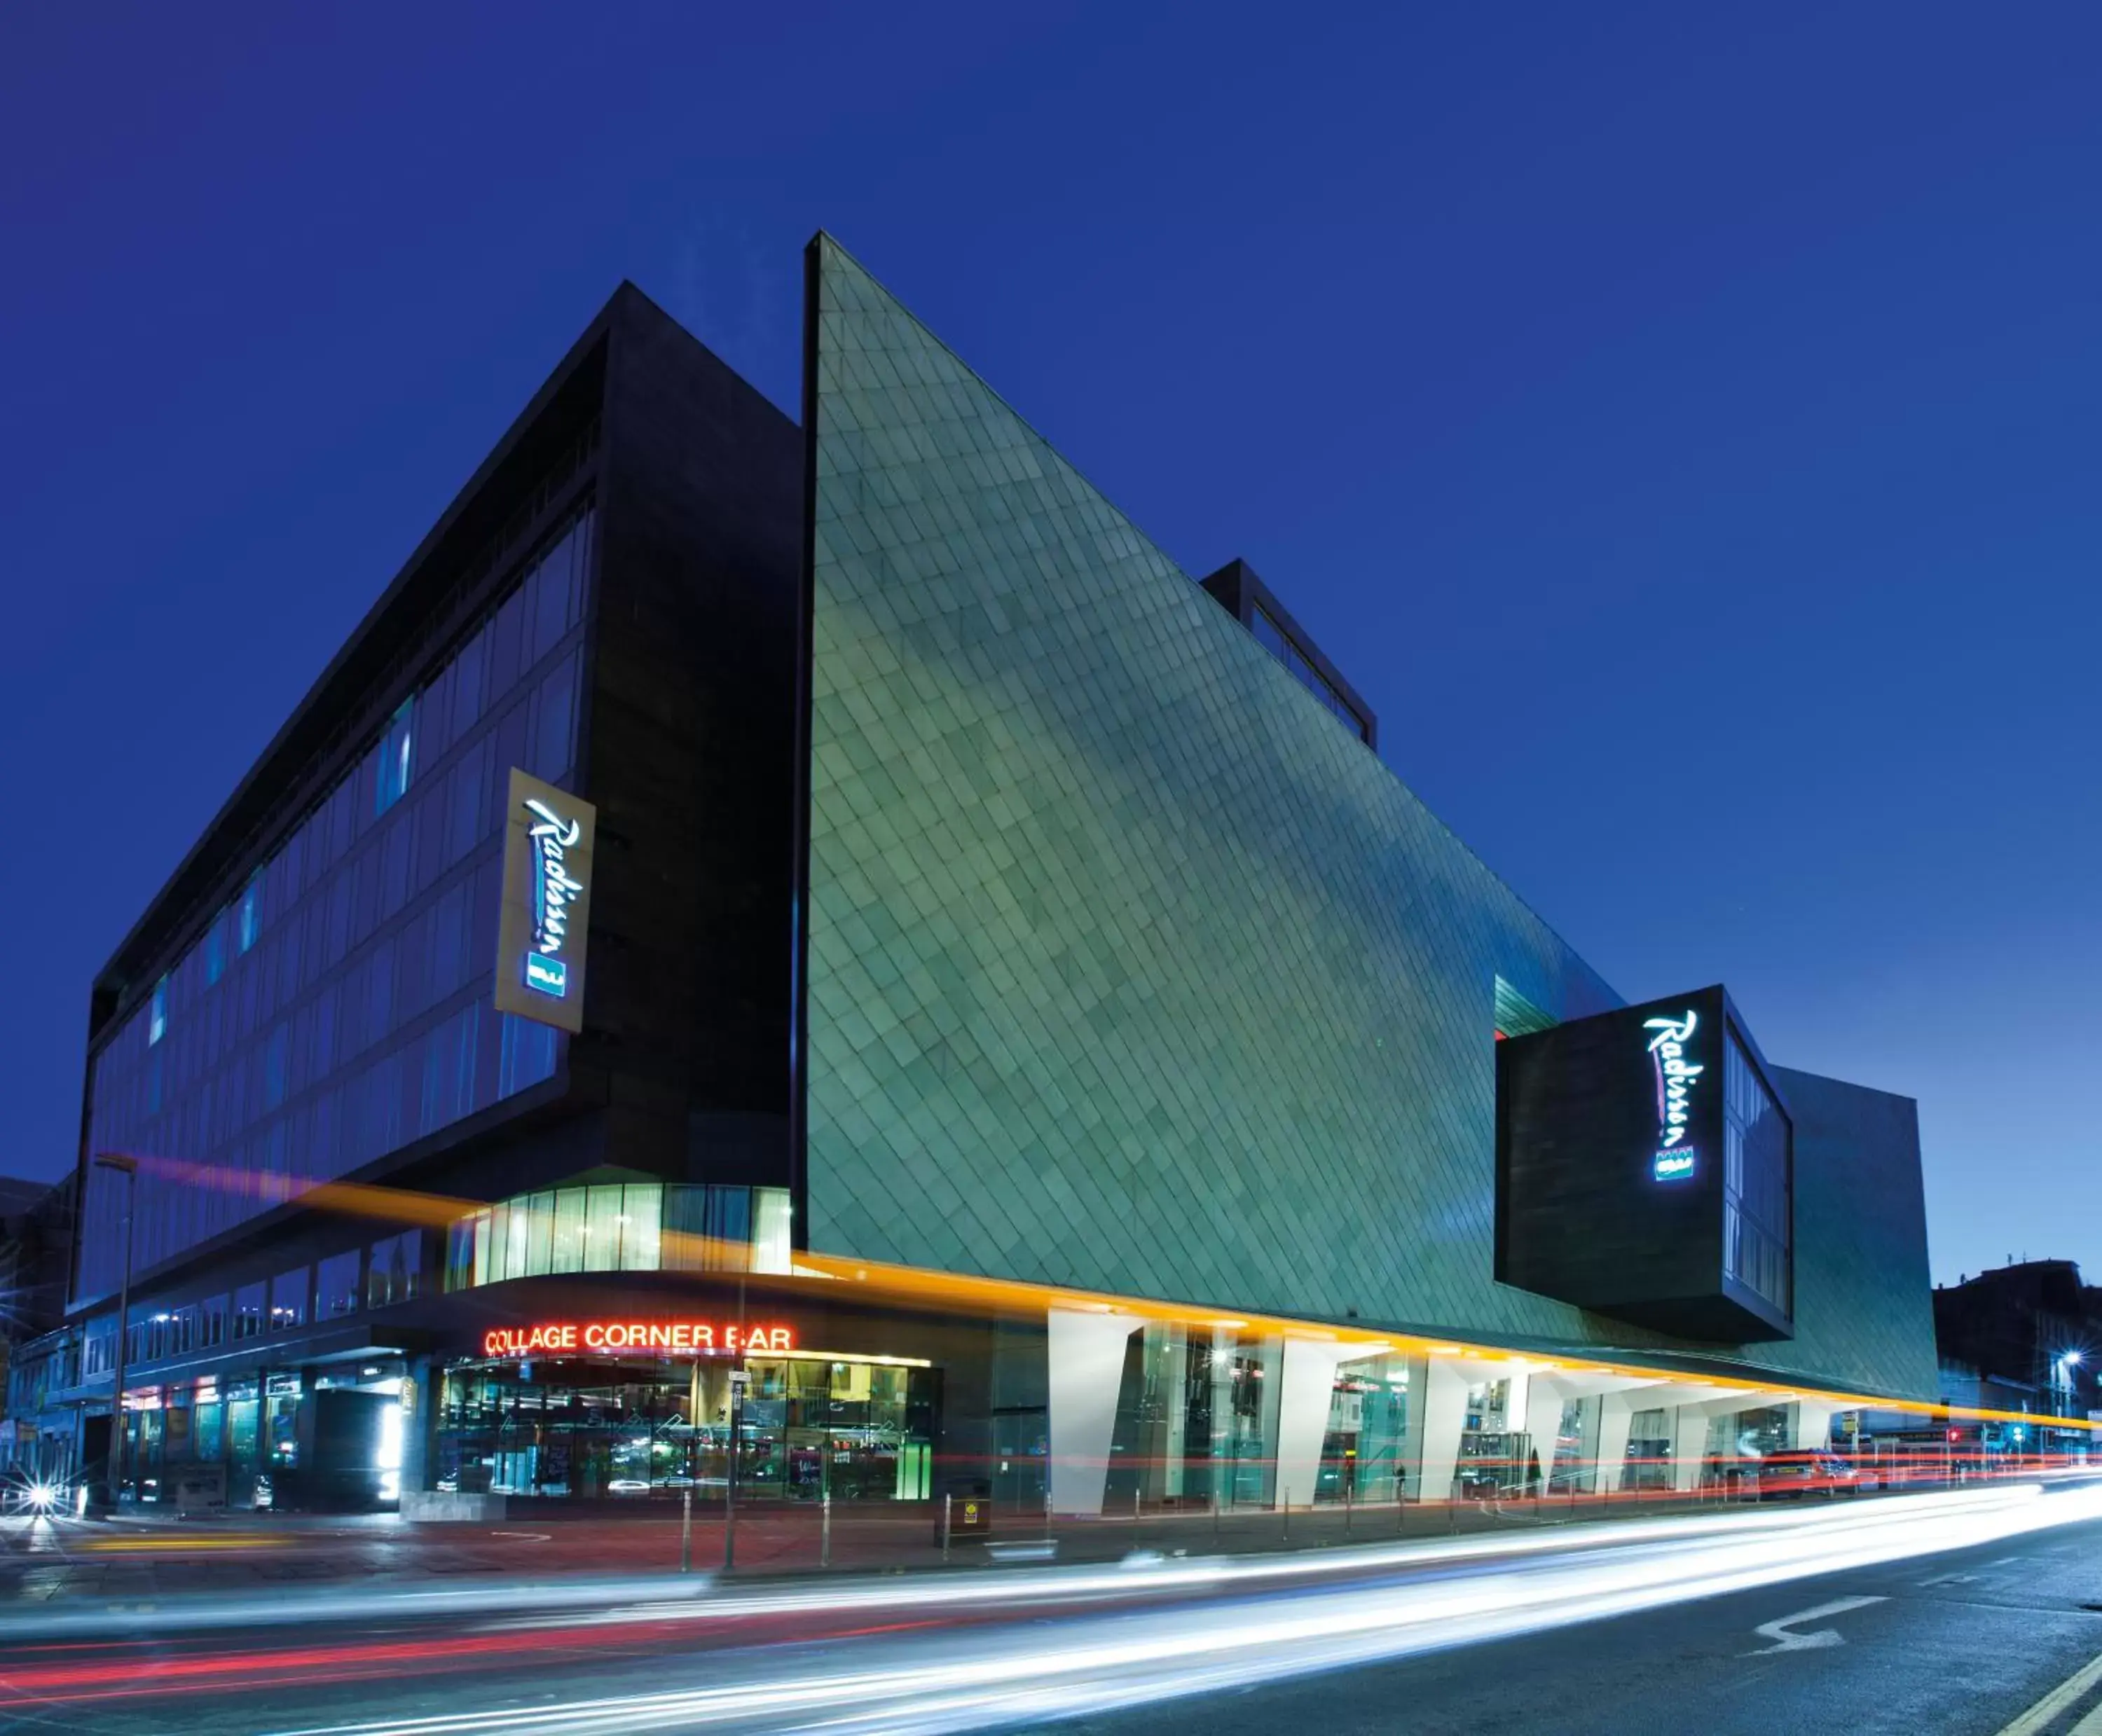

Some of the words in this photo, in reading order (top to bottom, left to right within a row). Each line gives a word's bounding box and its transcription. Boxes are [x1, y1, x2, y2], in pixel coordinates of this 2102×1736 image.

[524, 799, 584, 954] Radisson
[1642, 1009, 1704, 1148] Radisson
[485, 1325, 577, 1353] COLLAGE
[585, 1325, 713, 1347] CORNER
